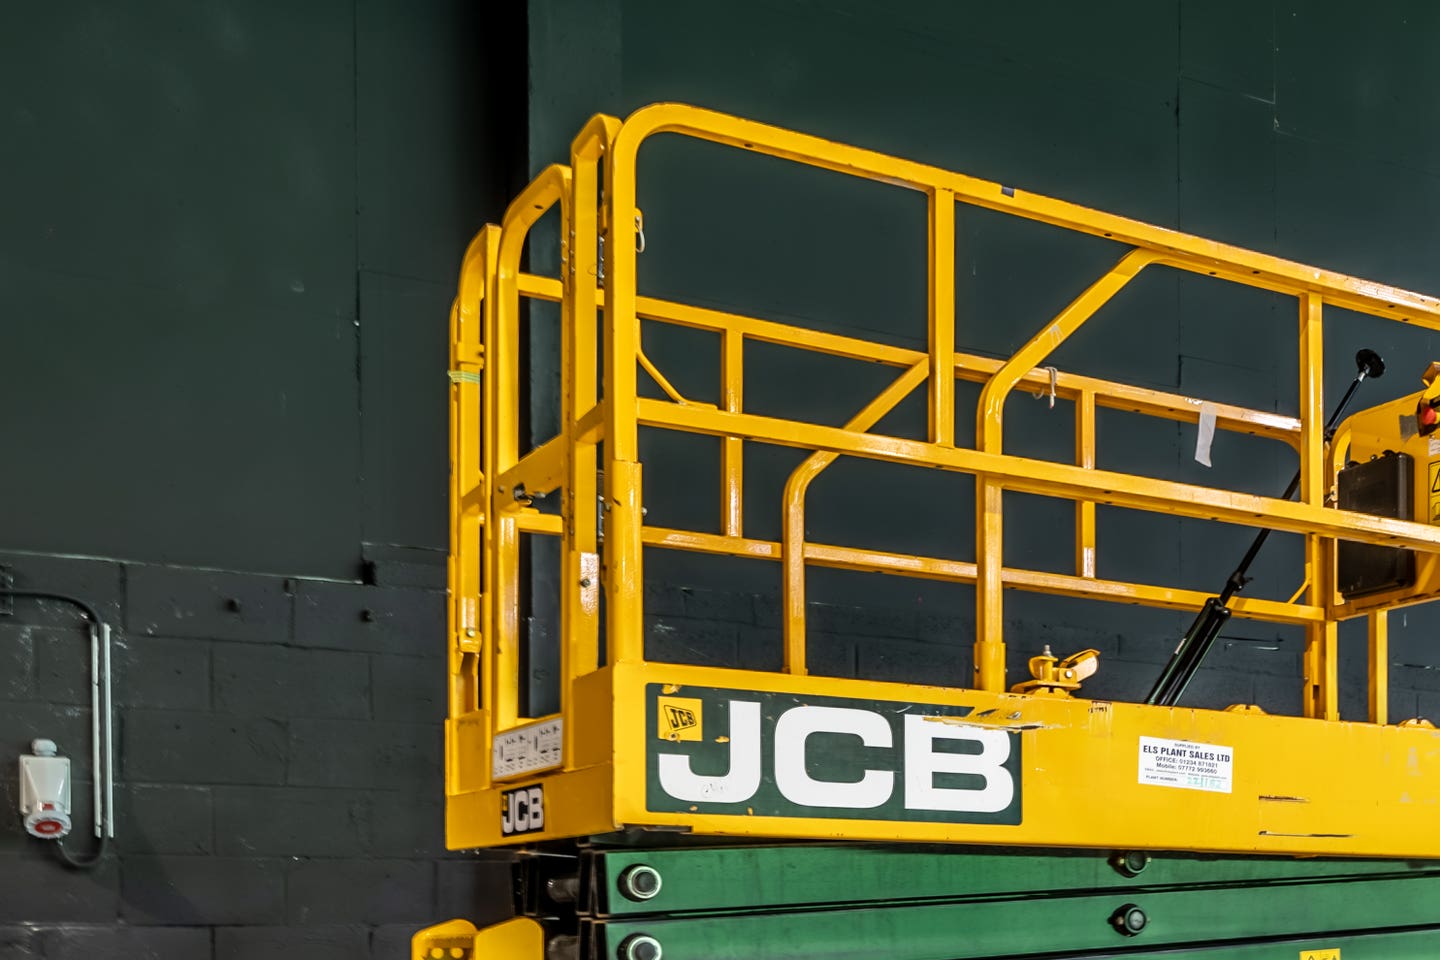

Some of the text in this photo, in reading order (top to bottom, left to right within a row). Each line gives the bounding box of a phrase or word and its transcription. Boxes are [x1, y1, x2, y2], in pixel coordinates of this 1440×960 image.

[669, 707, 695, 729] JCB
[657, 699, 1014, 813] JCB
[1143, 745, 1230, 763] ELS PLANT SALES LTD
[1155, 756, 1178, 764] OFFICE:
[1156, 762, 1177, 770] Mobile:
[502, 787, 544, 834] JCB
